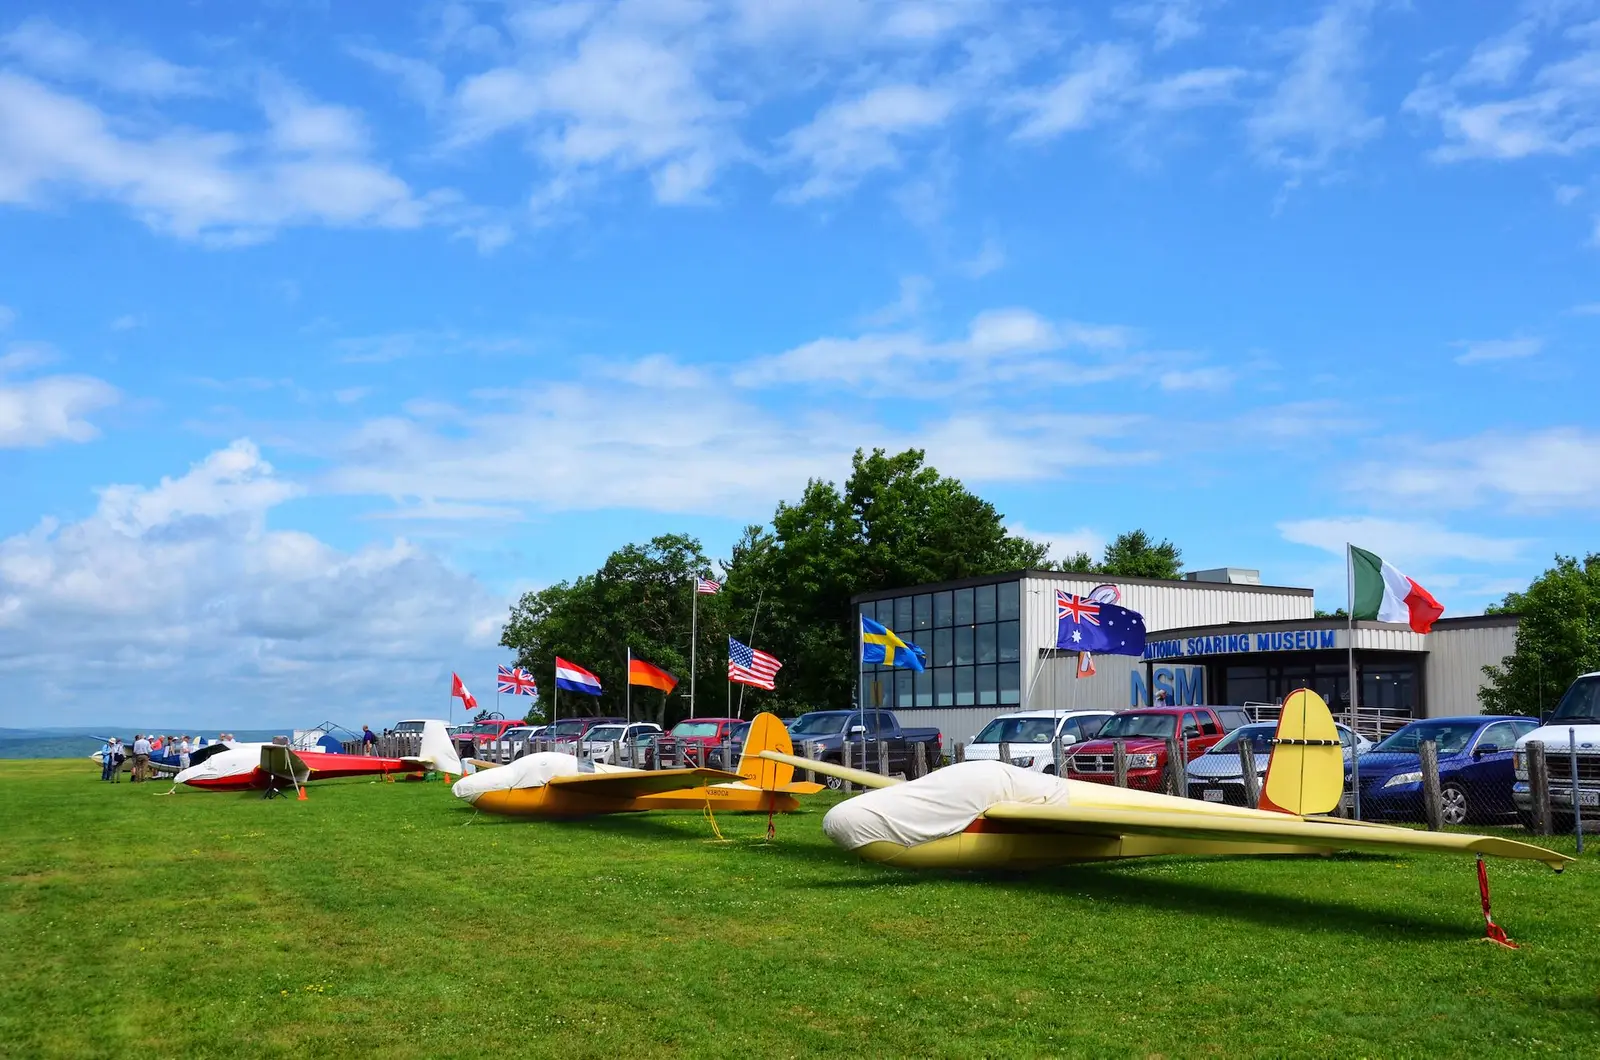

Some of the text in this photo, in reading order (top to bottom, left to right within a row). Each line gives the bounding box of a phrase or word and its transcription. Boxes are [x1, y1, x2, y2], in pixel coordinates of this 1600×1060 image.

[1144, 630, 1335, 660] NATIONAL SOARING MUSEUM
[1131, 667, 1203, 706] NSM
